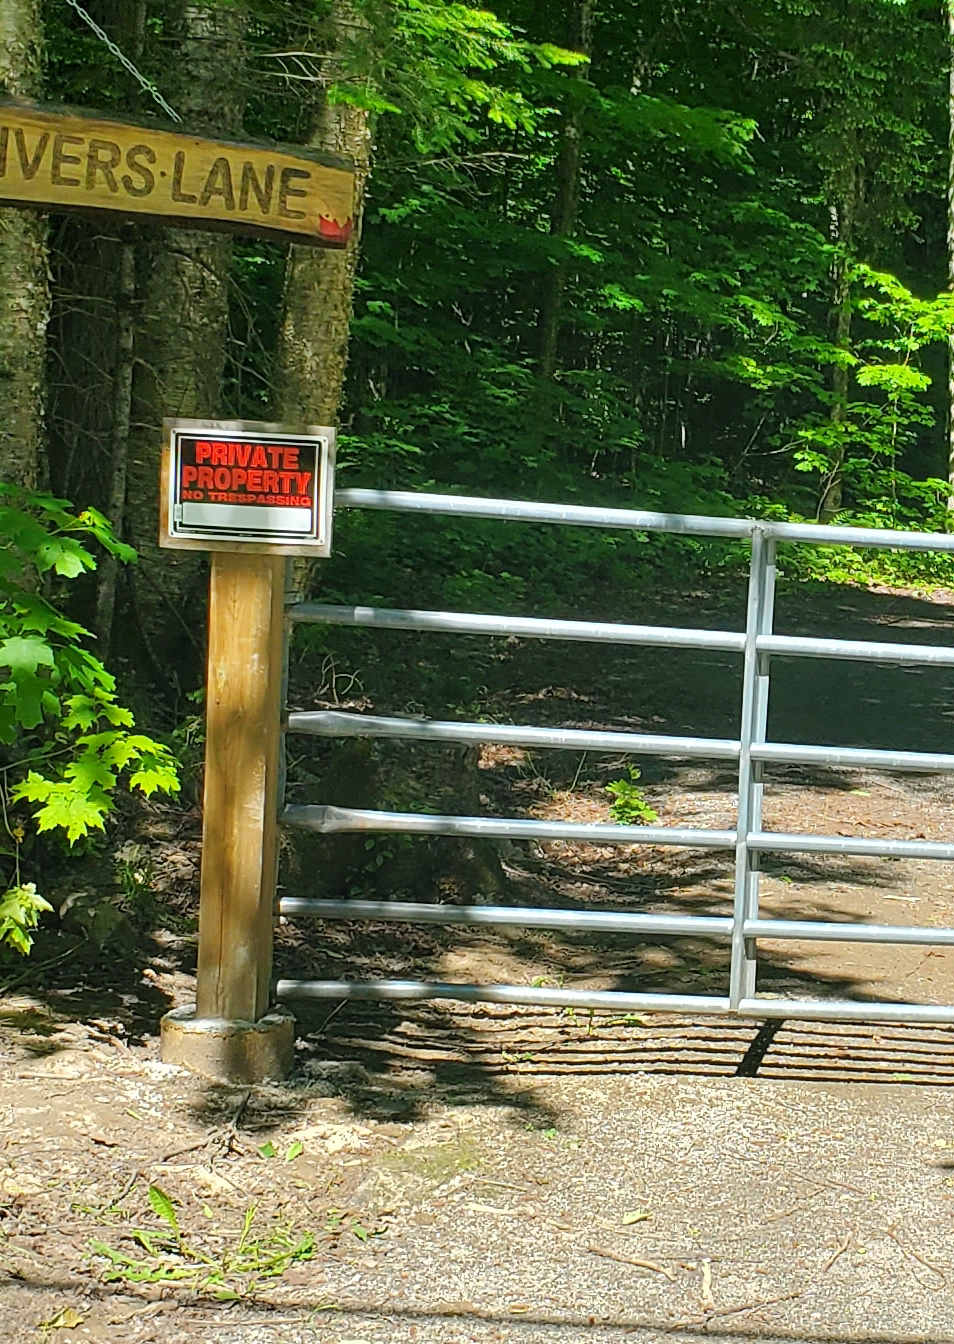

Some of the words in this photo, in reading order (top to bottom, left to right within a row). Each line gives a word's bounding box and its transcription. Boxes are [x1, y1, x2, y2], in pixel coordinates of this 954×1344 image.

[172, 151, 312, 220] LANE
[195, 441, 299, 469] PRIVATE
[182, 465, 312, 494] PROPERTY
[182, 489, 204, 500] NO
[207, 491, 312, 507] TRESPASSING
